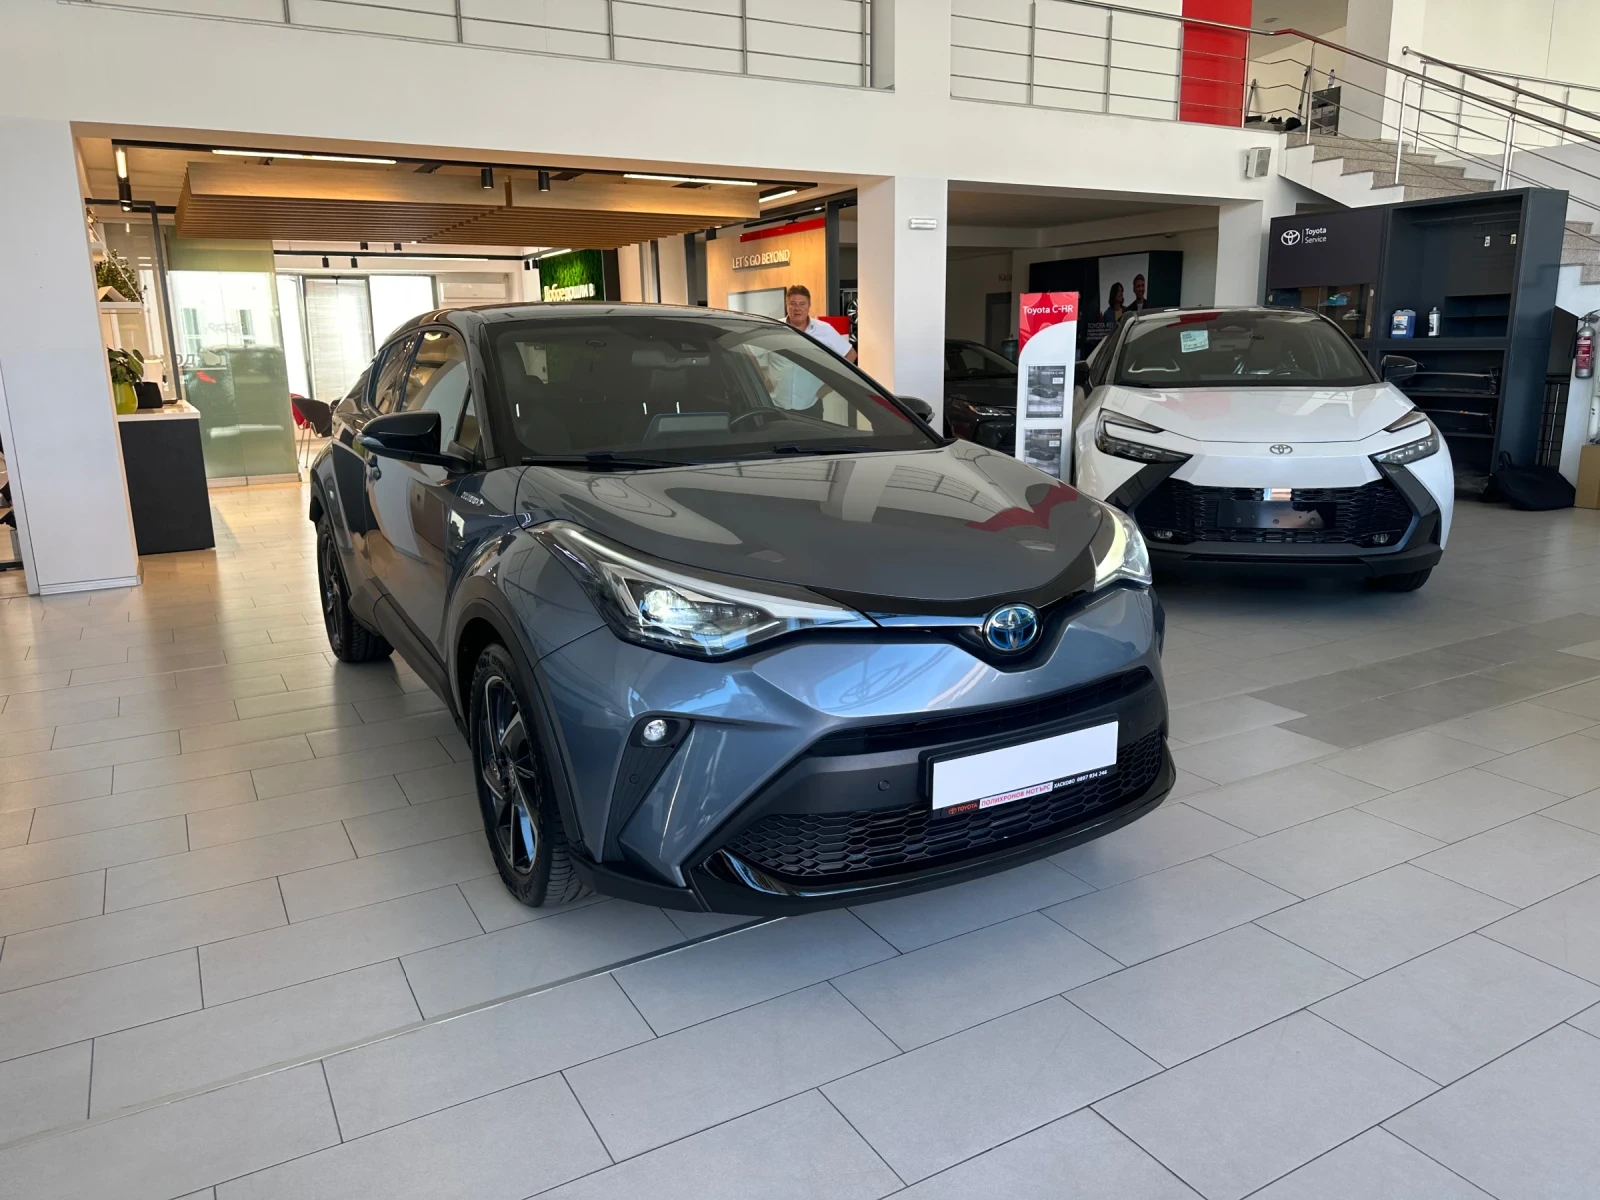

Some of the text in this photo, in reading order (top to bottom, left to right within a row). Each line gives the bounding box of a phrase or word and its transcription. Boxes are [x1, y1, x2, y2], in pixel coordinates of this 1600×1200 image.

[1305, 227, 1326, 236] Toyota
[750, 254, 761, 266] GO
[761, 249, 790, 265] BEYOND
[1023, 304, 1074, 316] Toyota C-HR
[957, 802, 978, 812] TOYOTA
[981, 791, 1024, 807] ПОЛИХРОНОВ
[1025, 784, 1051, 796] МОТЪРС
